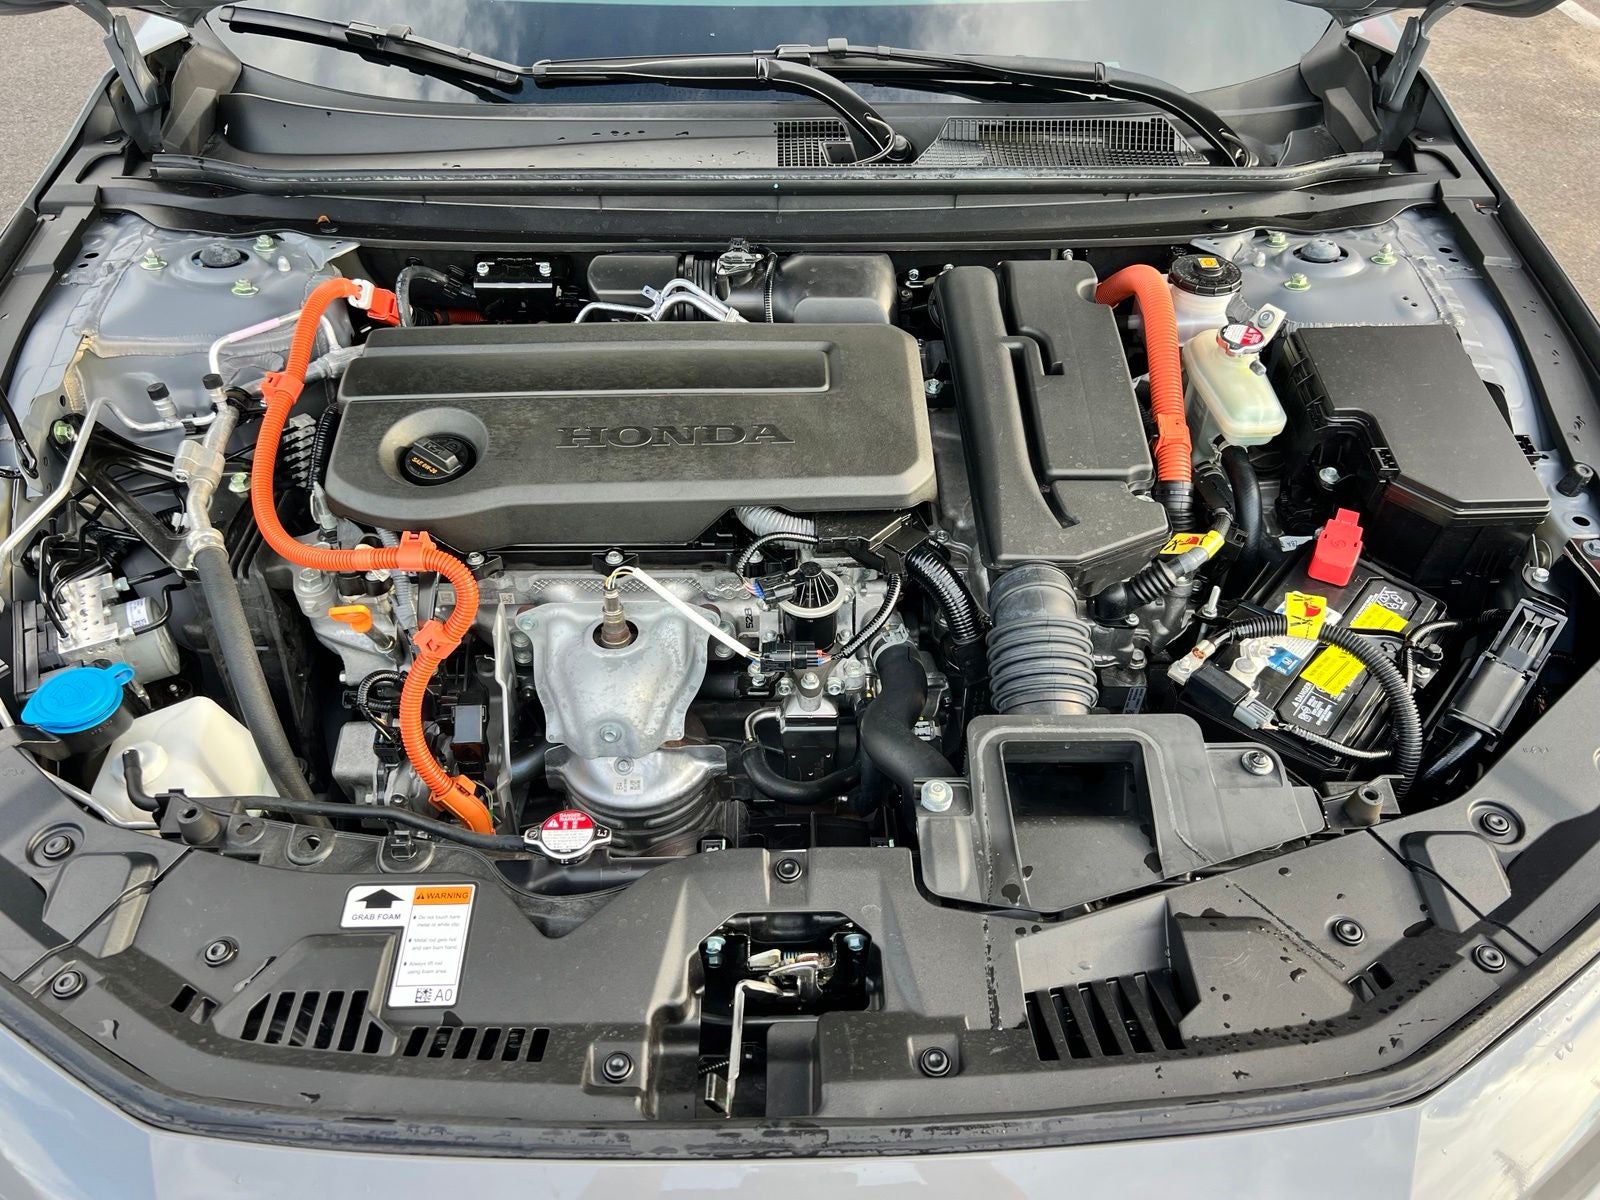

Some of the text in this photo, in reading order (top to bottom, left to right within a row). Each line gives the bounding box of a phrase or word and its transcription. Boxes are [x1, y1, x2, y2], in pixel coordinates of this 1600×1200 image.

[555, 423, 796, 449] HONDA
[1295, 682, 1313, 702] DANGER
[426, 892, 469, 900] WARNING
[351, 913, 375, 921] GRAB
[434, 988, 453, 1002] A0
